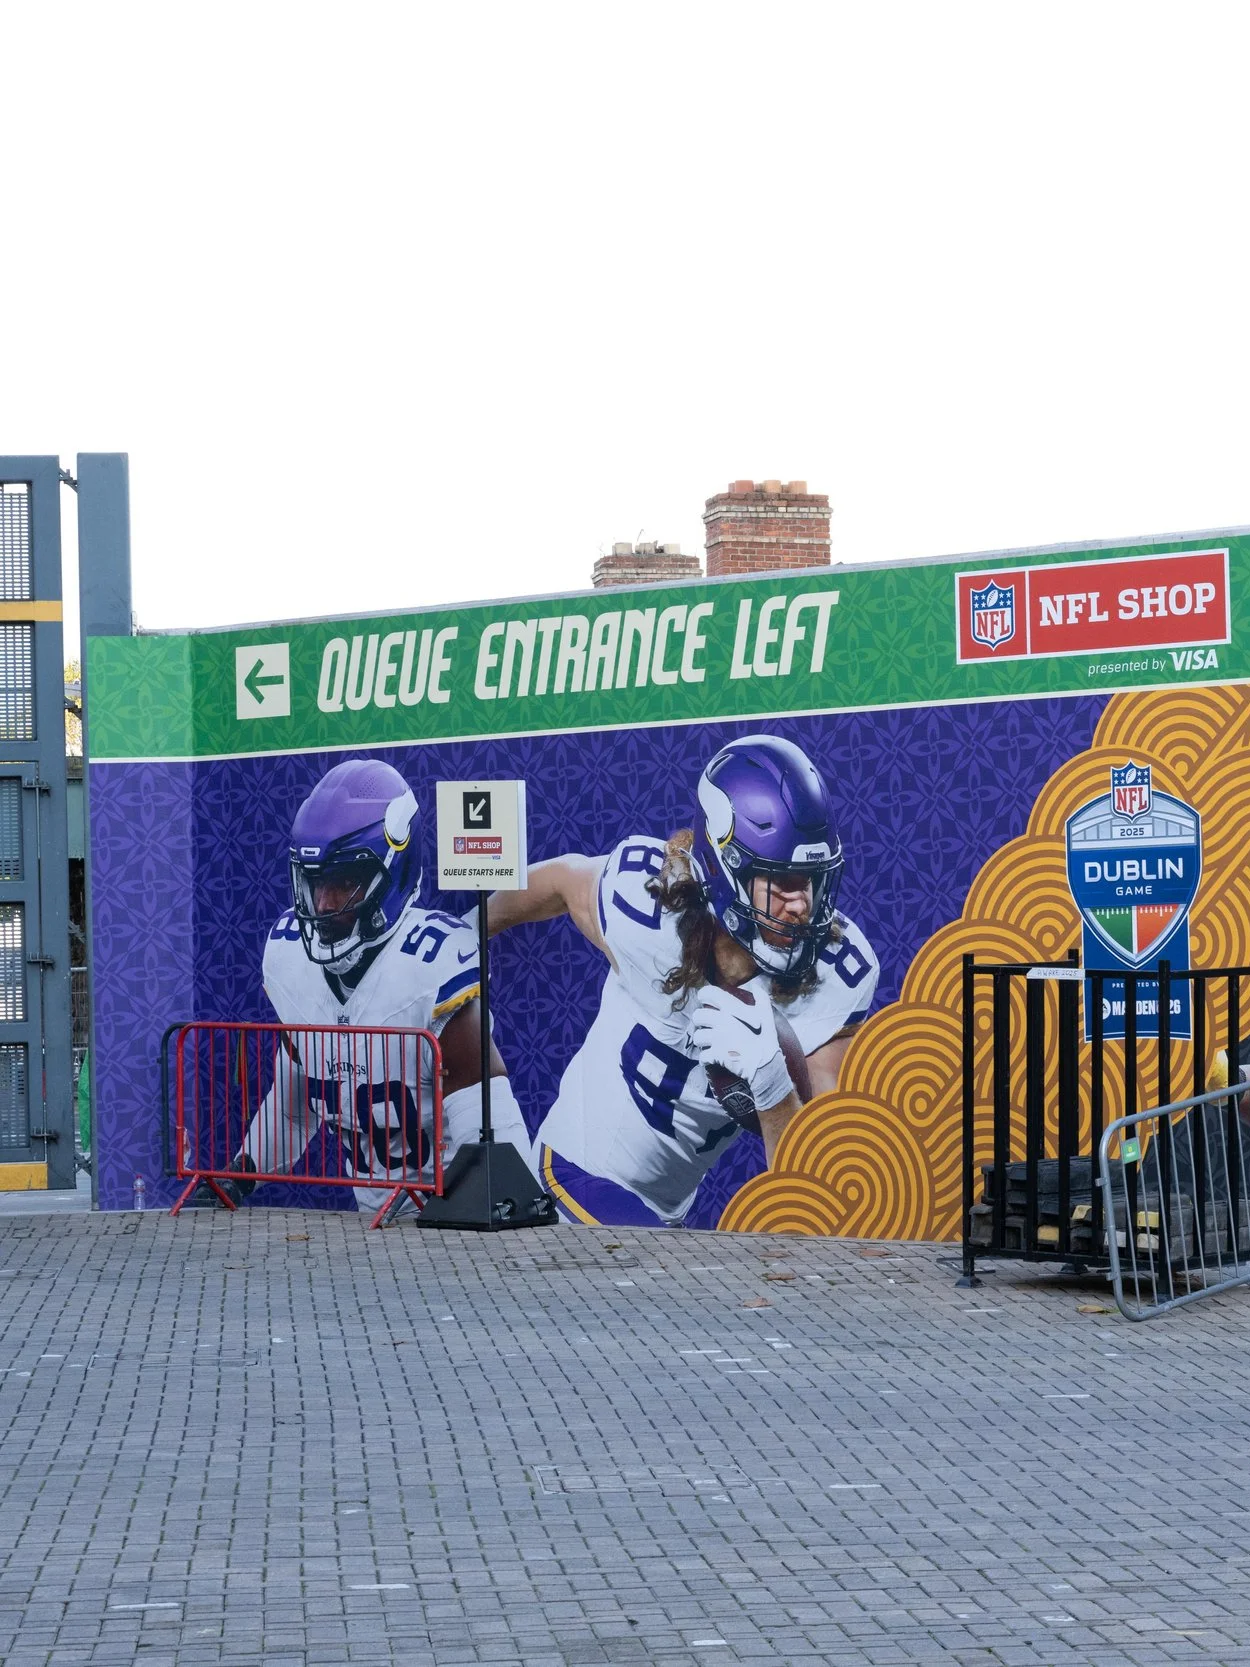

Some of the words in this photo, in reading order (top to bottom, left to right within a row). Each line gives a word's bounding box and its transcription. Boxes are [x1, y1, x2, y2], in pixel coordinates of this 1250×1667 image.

[1038, 591, 1109, 627] NFL
[1117, 582, 1216, 621] SHOP
[975, 610, 1010, 640] NFL
[317, 626, 459, 713] QUEUE
[474, 602, 714, 700] ENTRANCE
[730, 590, 840, 680] LEFT
[1087, 659, 1149, 677] presented
[1151, 657, 1167, 673] by
[1167, 648, 1219, 672] VISA
[1115, 787, 1148, 815] NFL
[1120, 826, 1145, 838] 2025
[443, 868, 467, 876] QUEUE
[468, 868, 494, 876] STARTS
[495, 868, 514, 876] HERE
[1084, 858, 1184, 883] DUBLIN
[1115, 885, 1153, 896] GAME
[1112, 1000, 1156, 1016] MADEN
